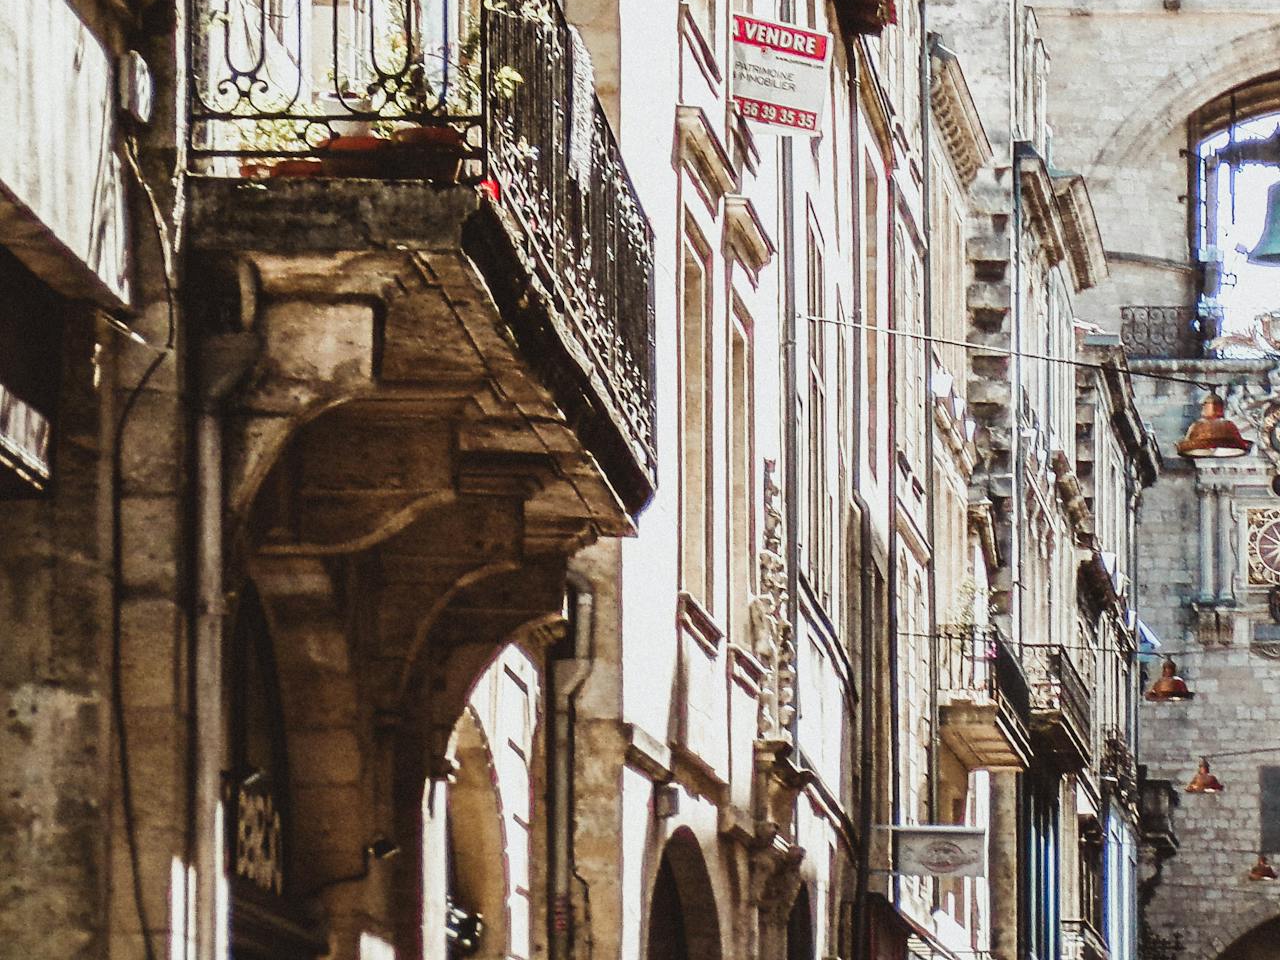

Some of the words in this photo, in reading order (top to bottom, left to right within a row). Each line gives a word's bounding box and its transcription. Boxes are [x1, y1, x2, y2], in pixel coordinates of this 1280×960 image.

[744, 20, 816, 54] VENDRE
[735, 60, 794, 82] PATRIMOINE
[738, 71, 796, 92] IMMOBILIER
[743, 101, 760, 116] 56
[761, 105, 777, 120] 39
[780, 108, 796, 124] 35
[797, 112, 815, 129] 35
